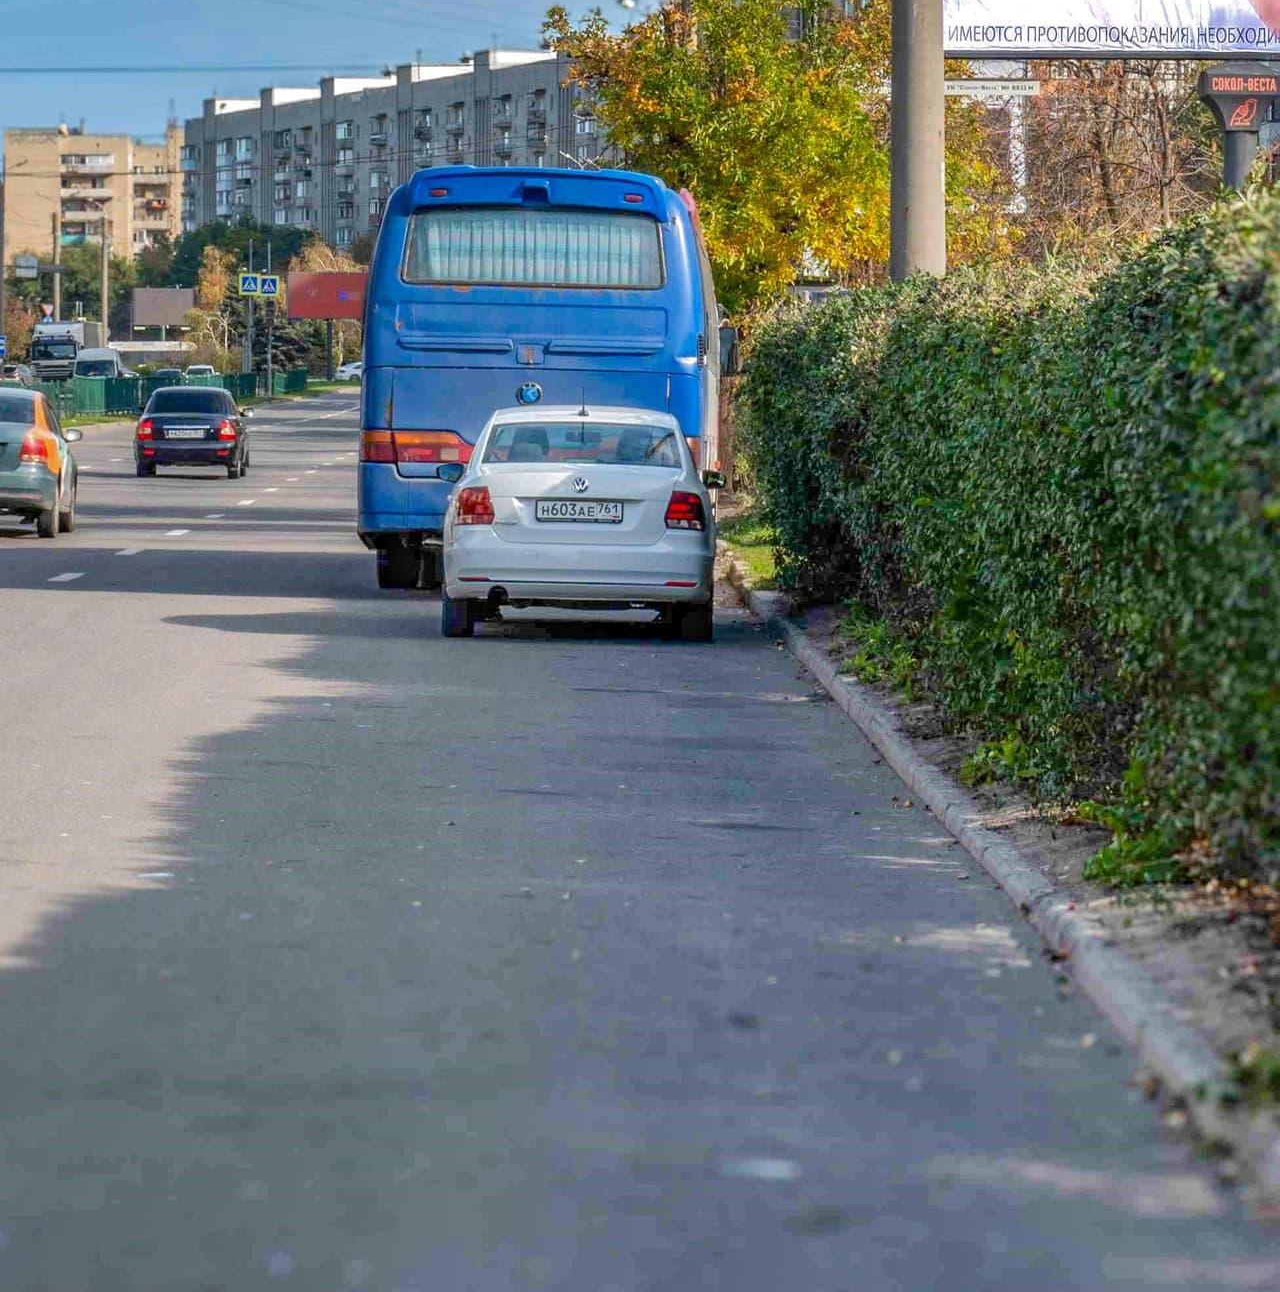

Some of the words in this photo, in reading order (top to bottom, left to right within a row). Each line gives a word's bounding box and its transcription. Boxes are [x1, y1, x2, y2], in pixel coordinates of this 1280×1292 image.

[948, 25, 1023, 43] ИМЕЮТСЯ
[1212, 76, 1277, 92] СОКОЛ-ВЕСТА
[541, 503, 595, 517] Н603АЕ
[598, 504, 618, 514] 761
